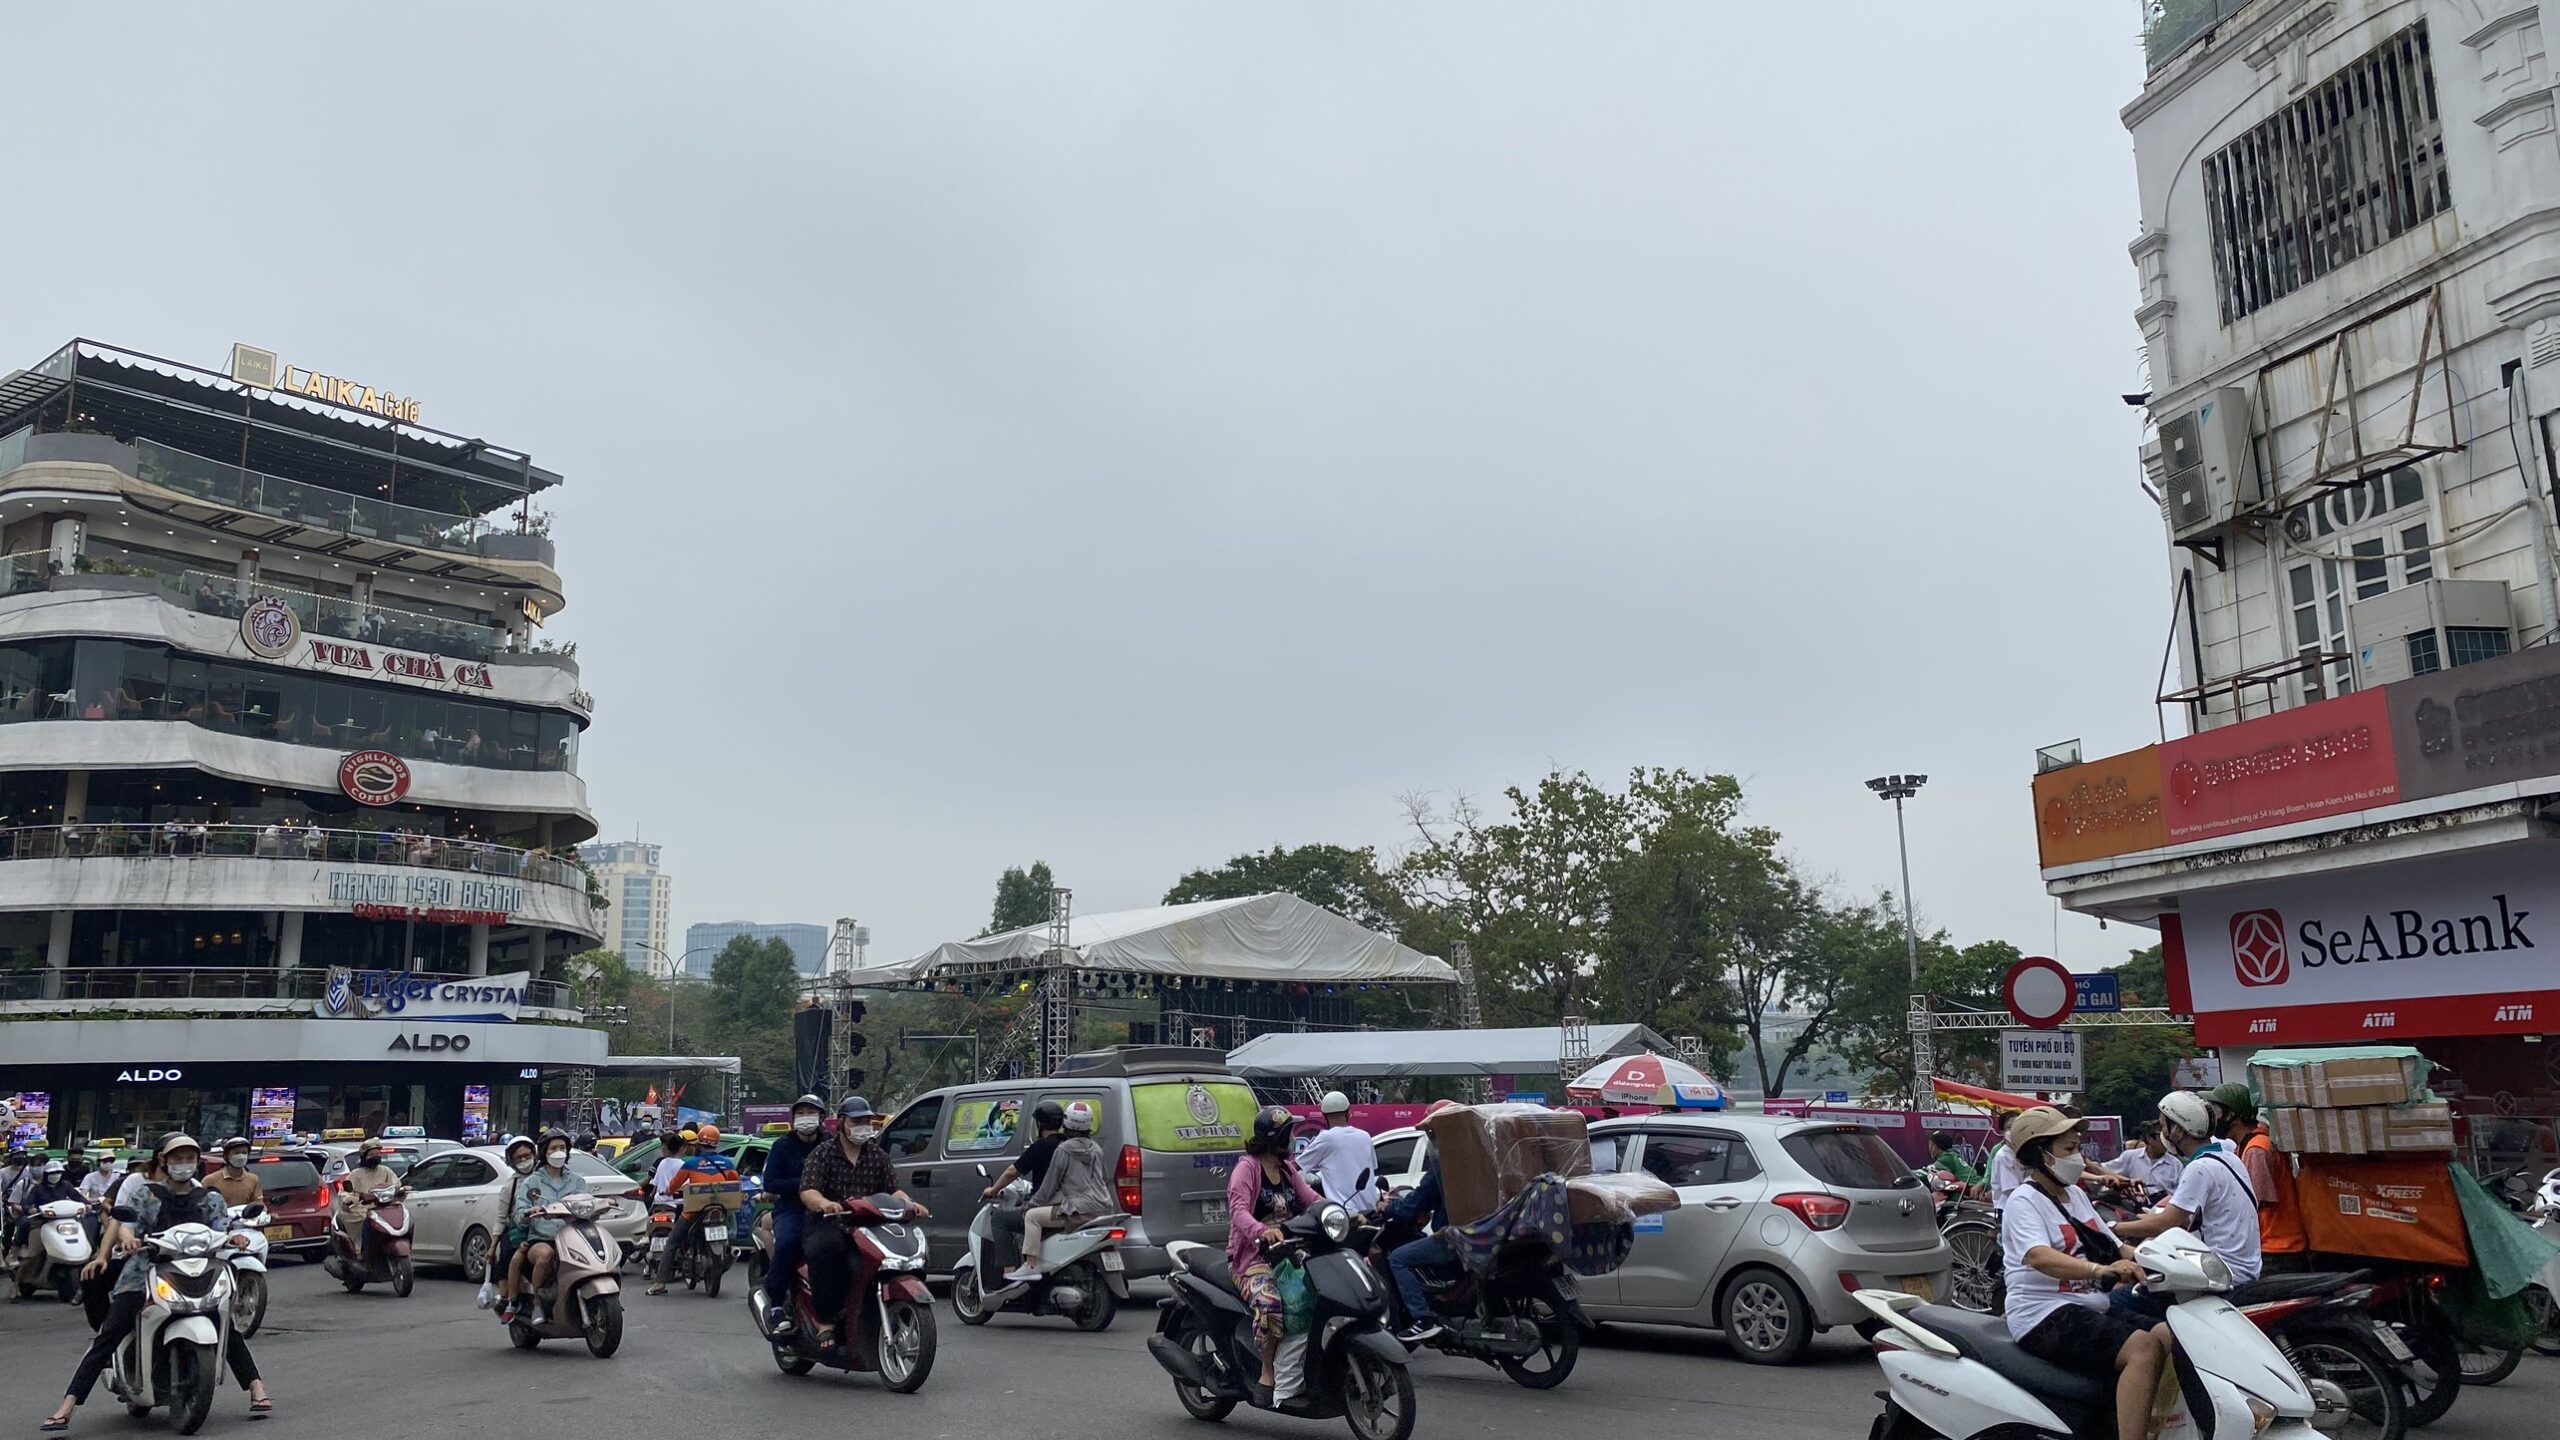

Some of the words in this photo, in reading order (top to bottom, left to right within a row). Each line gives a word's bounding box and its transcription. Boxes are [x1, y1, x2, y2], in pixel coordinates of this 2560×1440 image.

[241, 357, 270, 371] LAIKA
[284, 364, 379, 412] LAIKA
[383, 391, 422, 423] Café
[309, 639, 374, 671] VUA
[383, 653, 446, 682] CHẢ
[454, 660, 494, 689] CÁ
[344, 753, 407, 779] HIGHLANDS
[351, 787, 399, 803] COFFEE
[328, 872, 399, 902] HANOI
[406, 876, 454, 906] 1930
[461, 880, 524, 913] BISTRO
[353, 901, 408, 921] COFFEE
[2299, 894, 2535, 968] SeABank
[357, 968, 441, 1013] Tiger
[440, 984, 529, 1006] CRYSTAL
[2075, 979, 2091, 989] HỐ
[2090, 992, 2113, 1006] GAI
[2363, 1012, 2396, 1028] ATM
[2494, 1005, 2533, 1022] ATM
[2249, 1018, 2277, 1033] ATM
[387, 1034, 471, 1052] ALDO
[2008, 1037, 2034, 1053] TUYẾN
[2036, 1038, 2053, 1053] PHỐ
[116, 1069, 182, 1082] ALDO
[520, 1068, 538, 1079] ALDO
